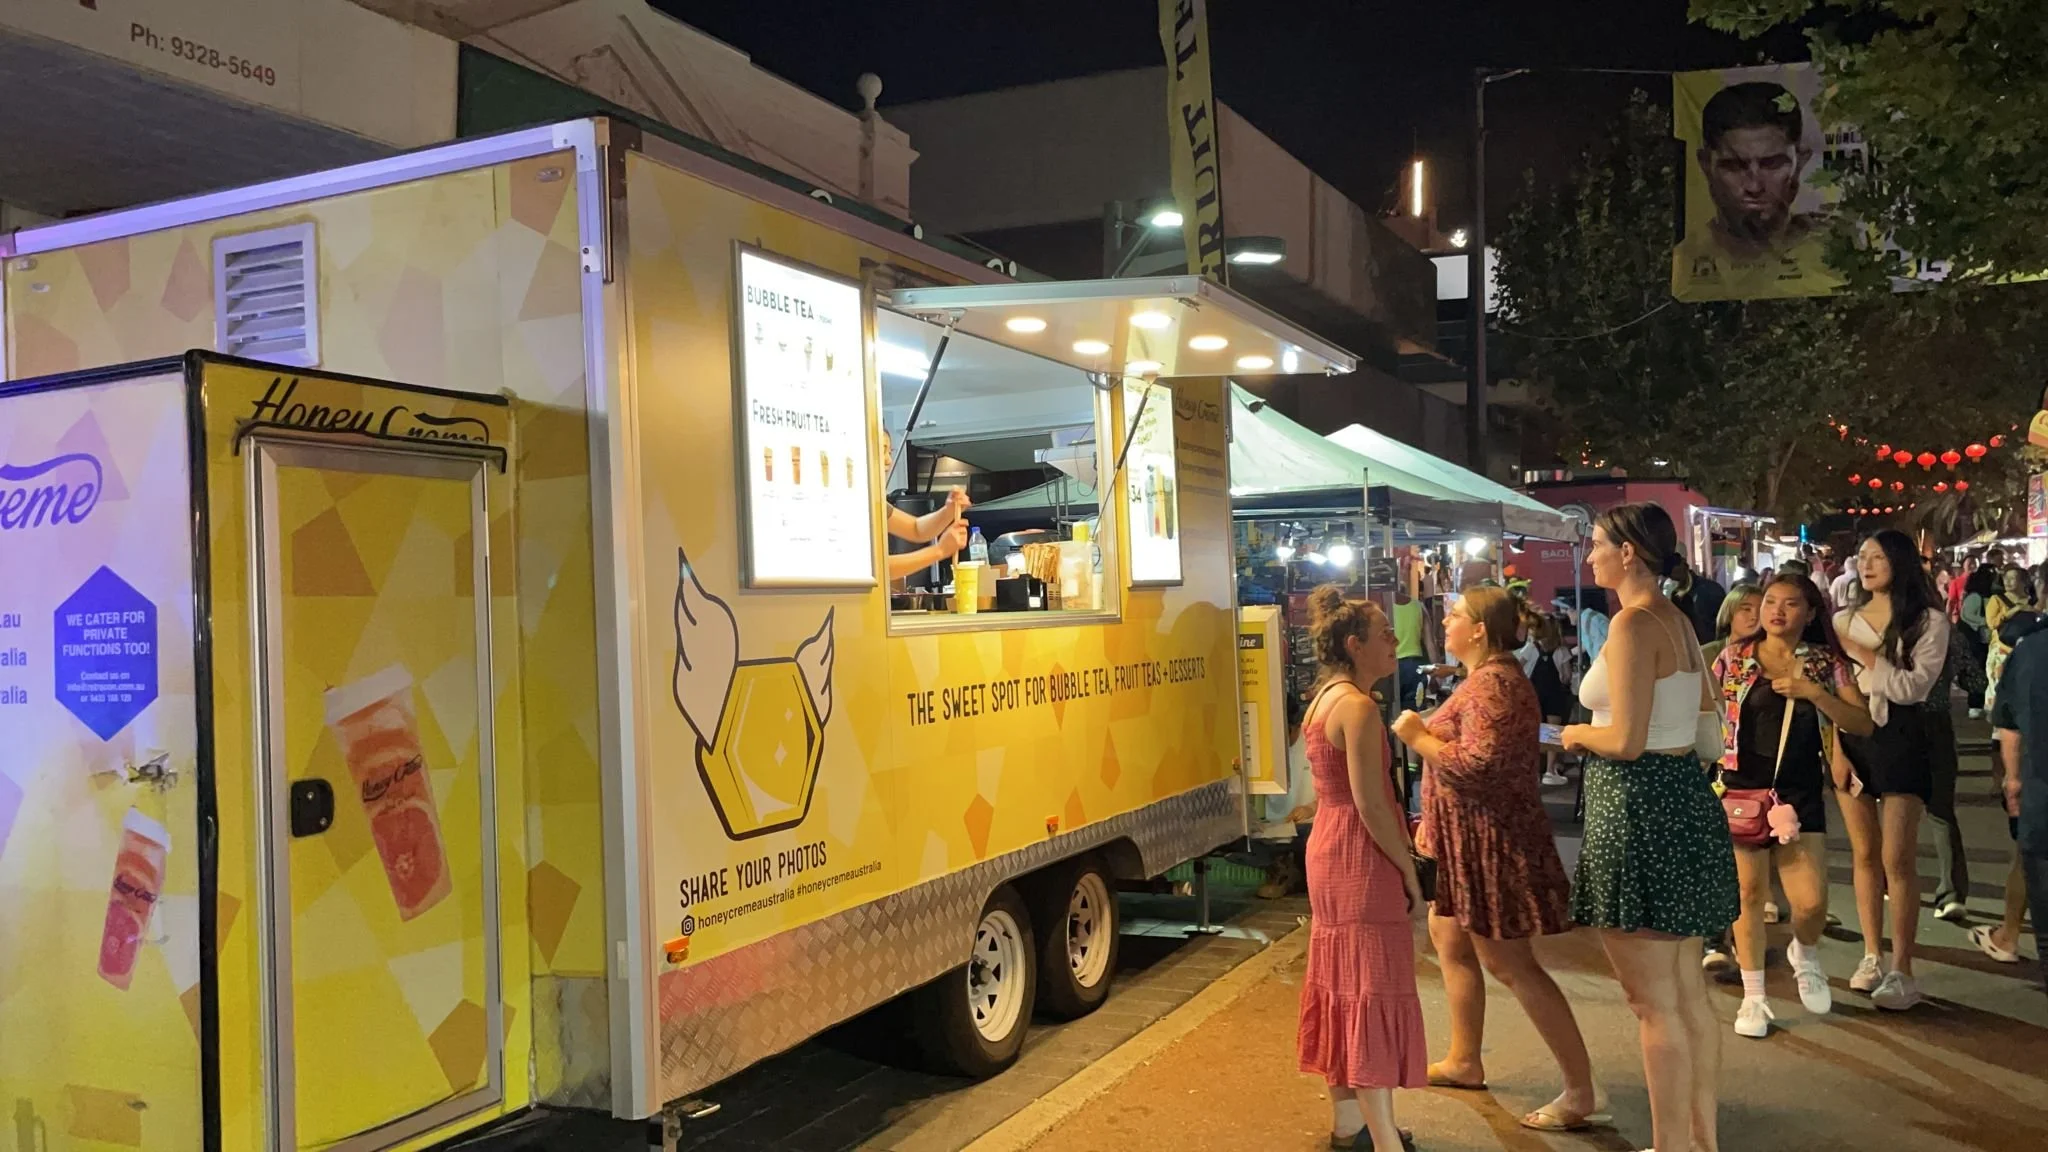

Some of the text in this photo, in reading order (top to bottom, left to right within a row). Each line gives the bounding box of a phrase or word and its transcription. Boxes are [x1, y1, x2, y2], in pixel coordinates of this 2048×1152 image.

[131, 23, 276, 87] Ph: 9328-5649
[747, 285, 791, 314] BUBBLE
[794, 298, 815, 320] TEA
[753, 398, 830, 433] FRESH FRUIT TEA
[66, 610, 145, 627] WE CATER FOR
[83, 627, 128, 641] PRIVATE
[62, 642, 150, 657] FUNCTIONS TOO!
[907, 691, 935, 726] THE
[943, 684, 986, 721] SWEET
[992, 679, 1020, 713] SPOT
[1026, 676, 1047, 706] FOR
[1050, 669, 1090, 702] BUBBLE
[1093, 667, 1113, 697] TEA,
[1115, 663, 1139, 692] FRUIT
[1142, 661, 1161, 687] TEAS
[680, 840, 827, 909] SHARE YOUR PHOTOS
[698, 859, 882, 930] honeycremeaustralia #honeycremeaustralia
